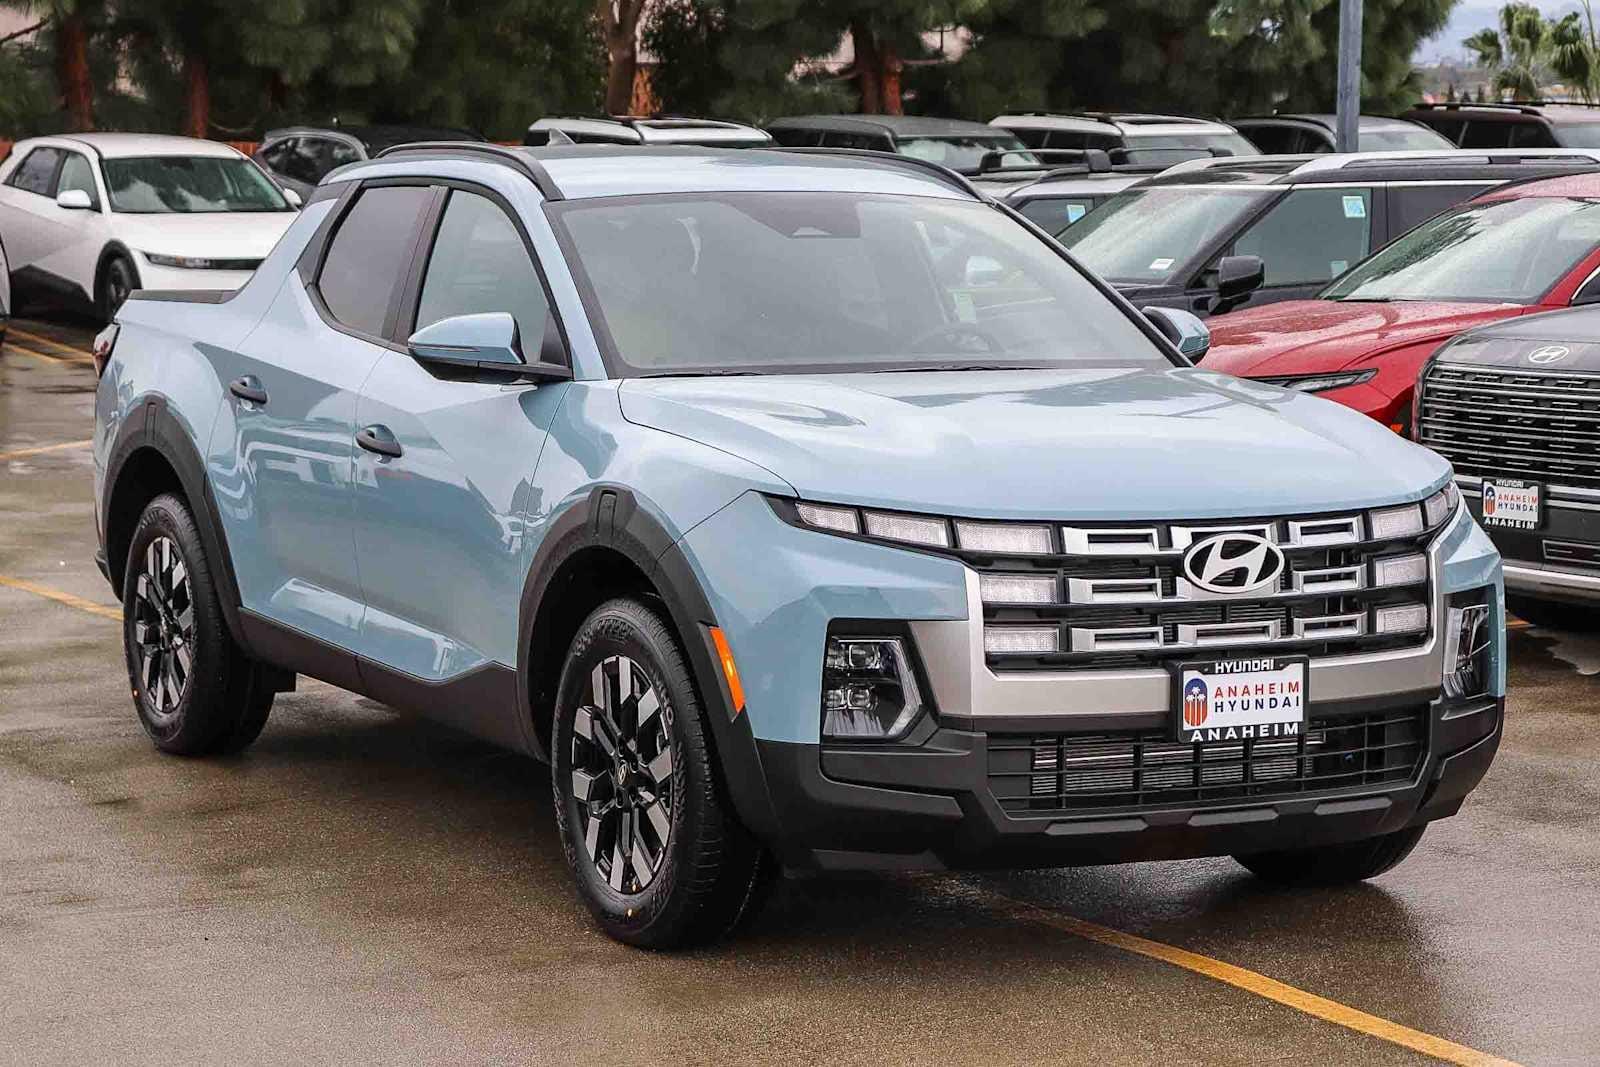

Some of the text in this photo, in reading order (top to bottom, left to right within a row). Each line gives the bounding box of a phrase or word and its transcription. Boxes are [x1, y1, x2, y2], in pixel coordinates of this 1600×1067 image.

[1495, 479, 1524, 488] HYUNDAI
[1498, 494, 1537, 504] ANAHEIM
[1498, 503, 1538, 512] HYUNDAI
[1484, 517, 1535, 529] ANAHEIM
[1215, 659, 1274, 674] HYUNDAI
[1214, 681, 1300, 699] ANAHEIM
[1214, 696, 1300, 713] HYUNDAI
[1190, 722, 1299, 742] ANAHEIM
